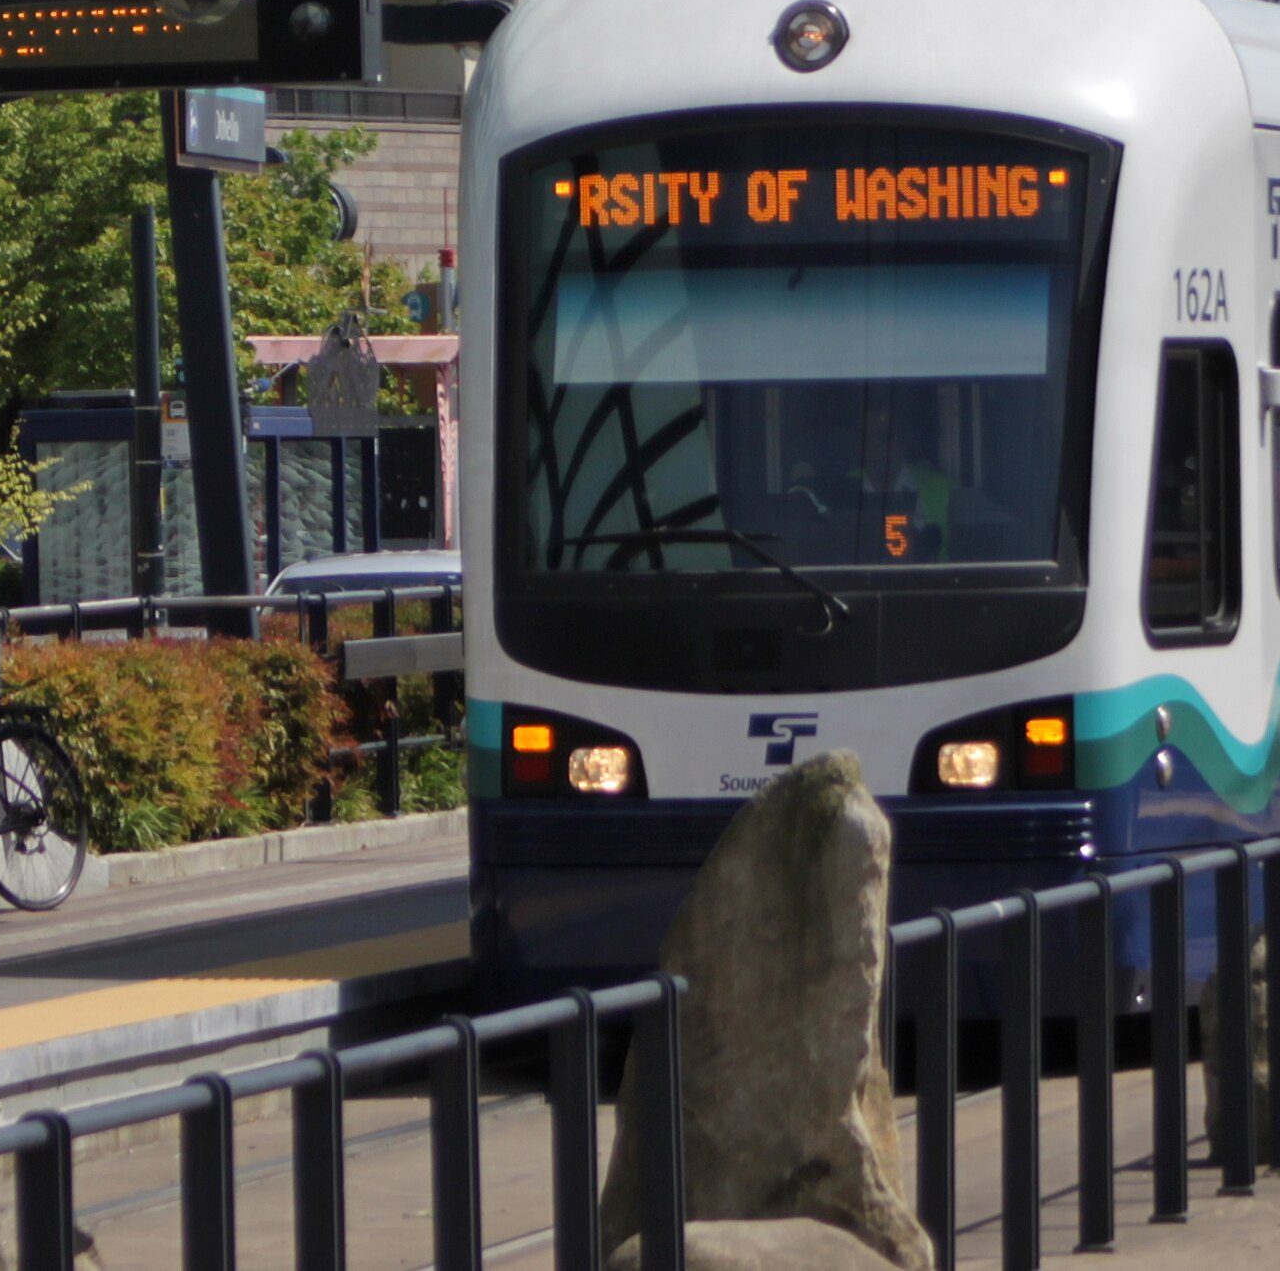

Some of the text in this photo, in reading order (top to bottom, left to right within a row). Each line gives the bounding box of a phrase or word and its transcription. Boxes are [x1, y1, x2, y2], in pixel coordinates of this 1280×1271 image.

[579, 165, 1039, 226] RSITY OF WASHING
[1174, 268, 1229, 322] 162A
[885, 515, 908, 557] 5
[719, 773, 770, 792] SOUN
